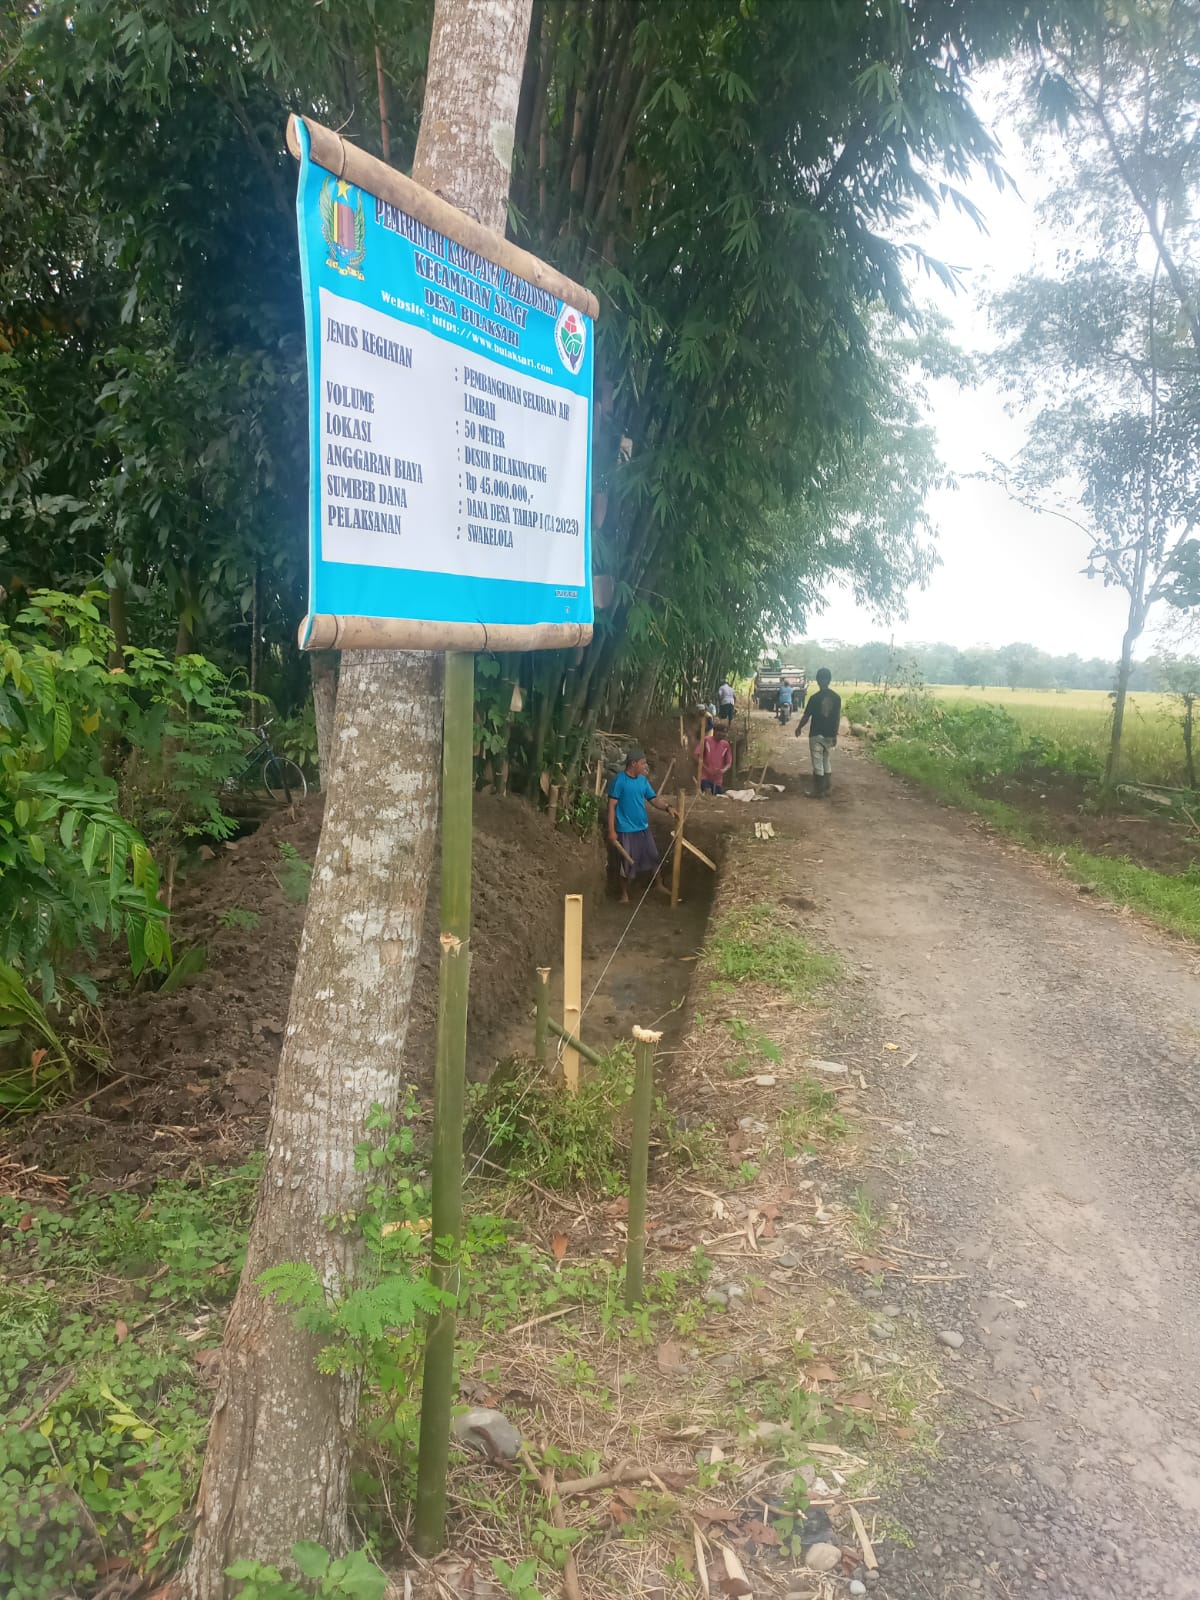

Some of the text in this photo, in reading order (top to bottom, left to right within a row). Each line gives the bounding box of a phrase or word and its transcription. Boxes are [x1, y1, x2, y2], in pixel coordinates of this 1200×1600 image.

[376, 198, 446, 260] PEMERINTAH
[381, 290, 425, 317] Website
[414, 251, 492, 311] KECAMATAN
[494, 292, 528, 329] SRAGI
[424, 288, 520, 347] DESA BULAKSARI
[327, 317, 359, 349] JENIS
[362, 329, 413, 369] KEGIATAN
[464, 366, 522, 406] PEMBANGUNAN
[326, 380, 375, 414] VOLUME
[464, 419, 476, 440] 50
[478, 424, 505, 449] METER
[464, 392, 496, 422] LIMBAH
[326, 411, 372, 443] LOKASI
[464, 445, 491, 470] DUSUN
[327, 443, 391, 477] ANGGARAN
[395, 458, 423, 484] BIAYA
[465, 472, 477, 494] Rp
[327, 474, 376, 503] SUMBER
[379, 483, 408, 509] DANA
[467, 498, 488, 520] DANA
[490, 503, 511, 524] DESA
[513, 507, 538, 528] TAHAP
[327, 504, 401, 536] PELAKSANAN
[467, 523, 514, 548] SWAKELOLA
